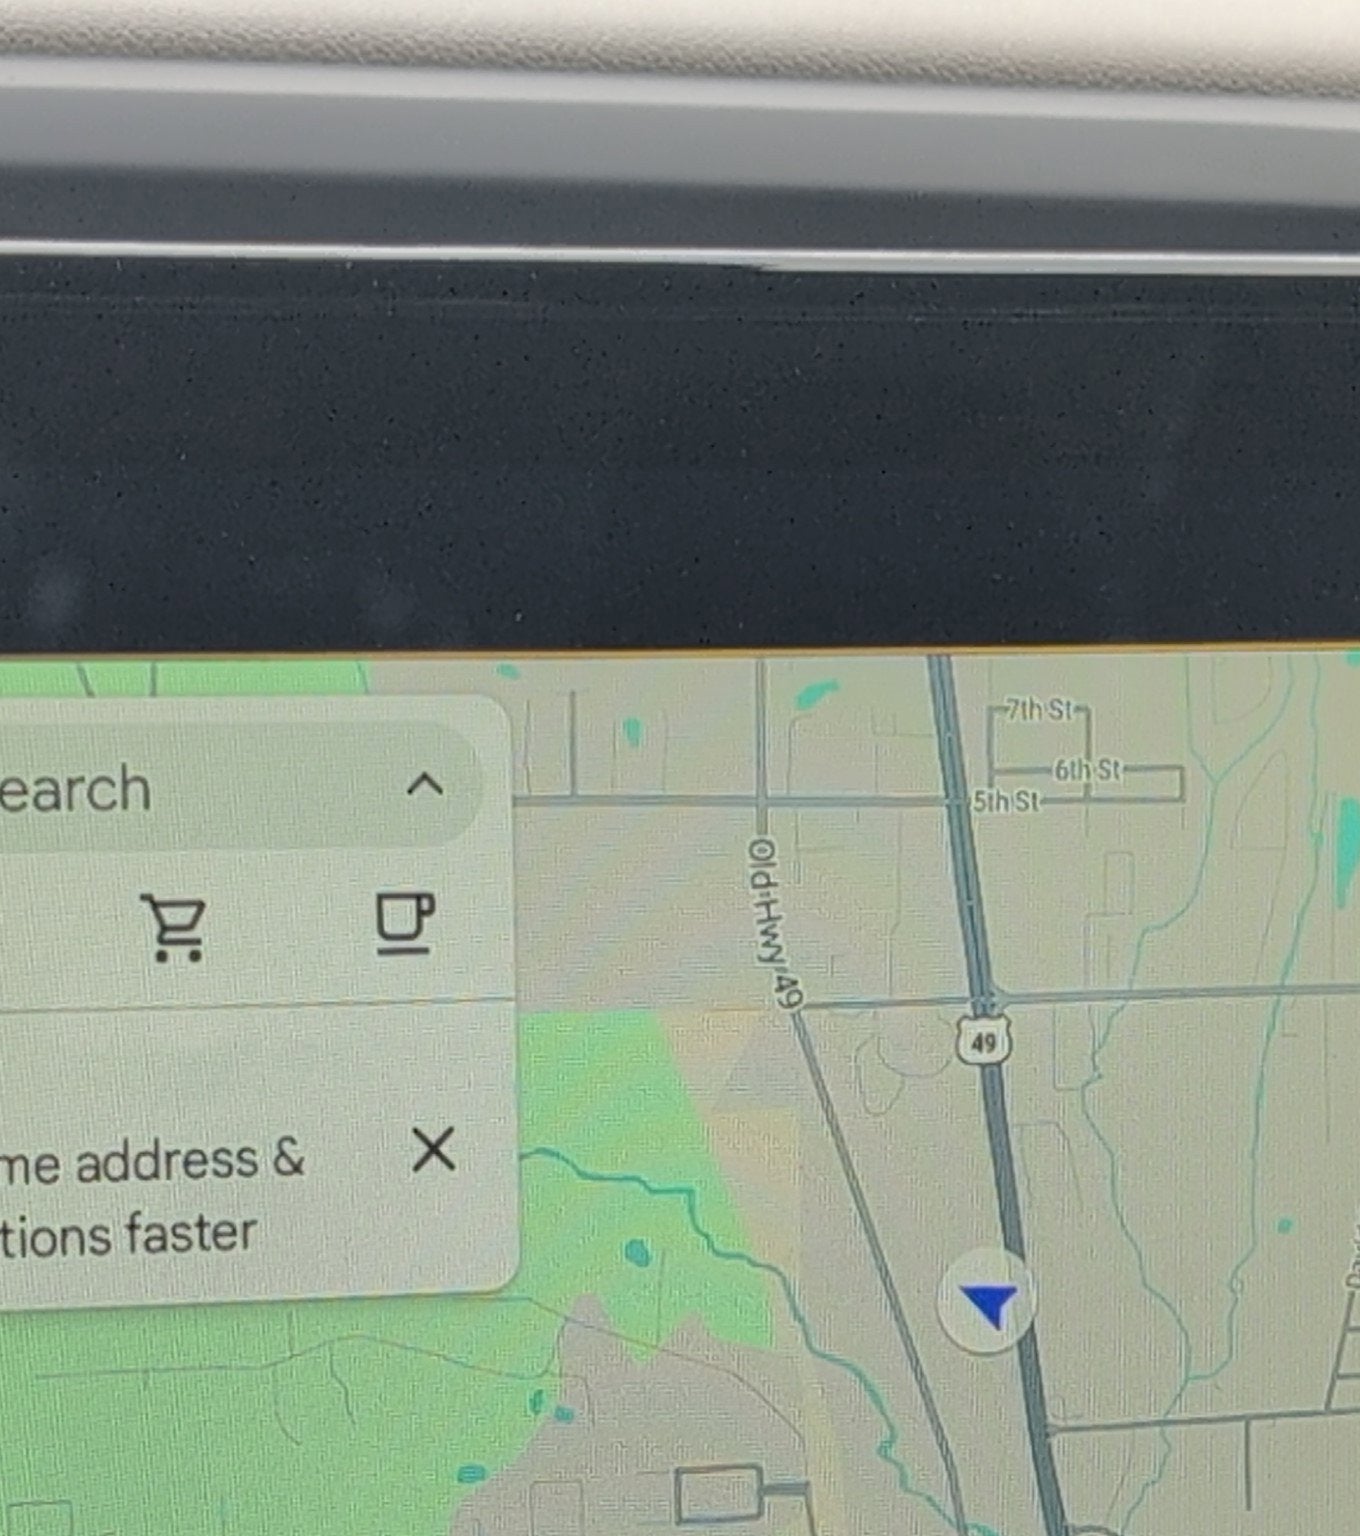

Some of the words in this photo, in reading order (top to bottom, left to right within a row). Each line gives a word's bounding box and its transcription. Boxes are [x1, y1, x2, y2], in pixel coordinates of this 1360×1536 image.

[1006, 696, 1041, 721] 7th
[1048, 698, 1072, 720] St
[1055, 758, 1090, 781] 6th
[1099, 757, 1120, 780] St
[973, 790, 1008, 813] 5th
[1016, 789, 1040, 812] St
[748, 838, 779, 889] Old
[753, 898, 786, 964] Hwy
[774, 974, 804, 1009] 49
[971, 1031, 996, 1054] 49
[76, 1136, 260, 1183] address
[273, 1134, 307, 1178] &
[124, 1209, 259, 1256] faster
